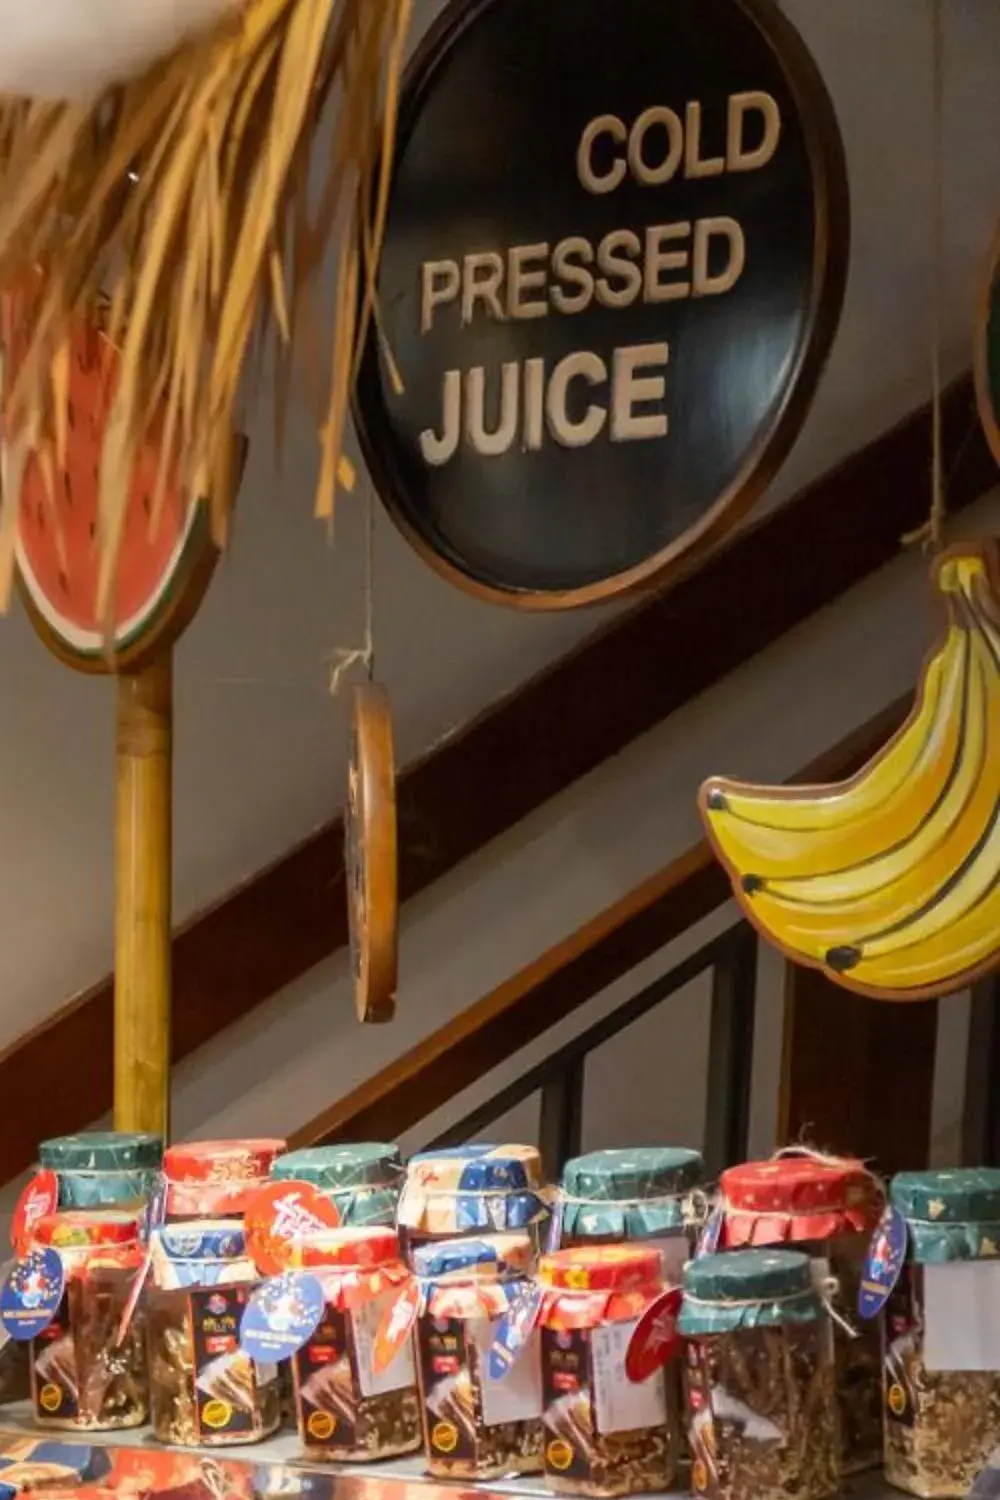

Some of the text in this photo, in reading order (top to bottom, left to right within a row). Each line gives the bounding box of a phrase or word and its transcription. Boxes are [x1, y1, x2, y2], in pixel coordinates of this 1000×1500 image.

[577, 91, 781, 194] COLD
[421, 216, 746, 335] PRESSED
[420, 342, 670, 467] JUICE
